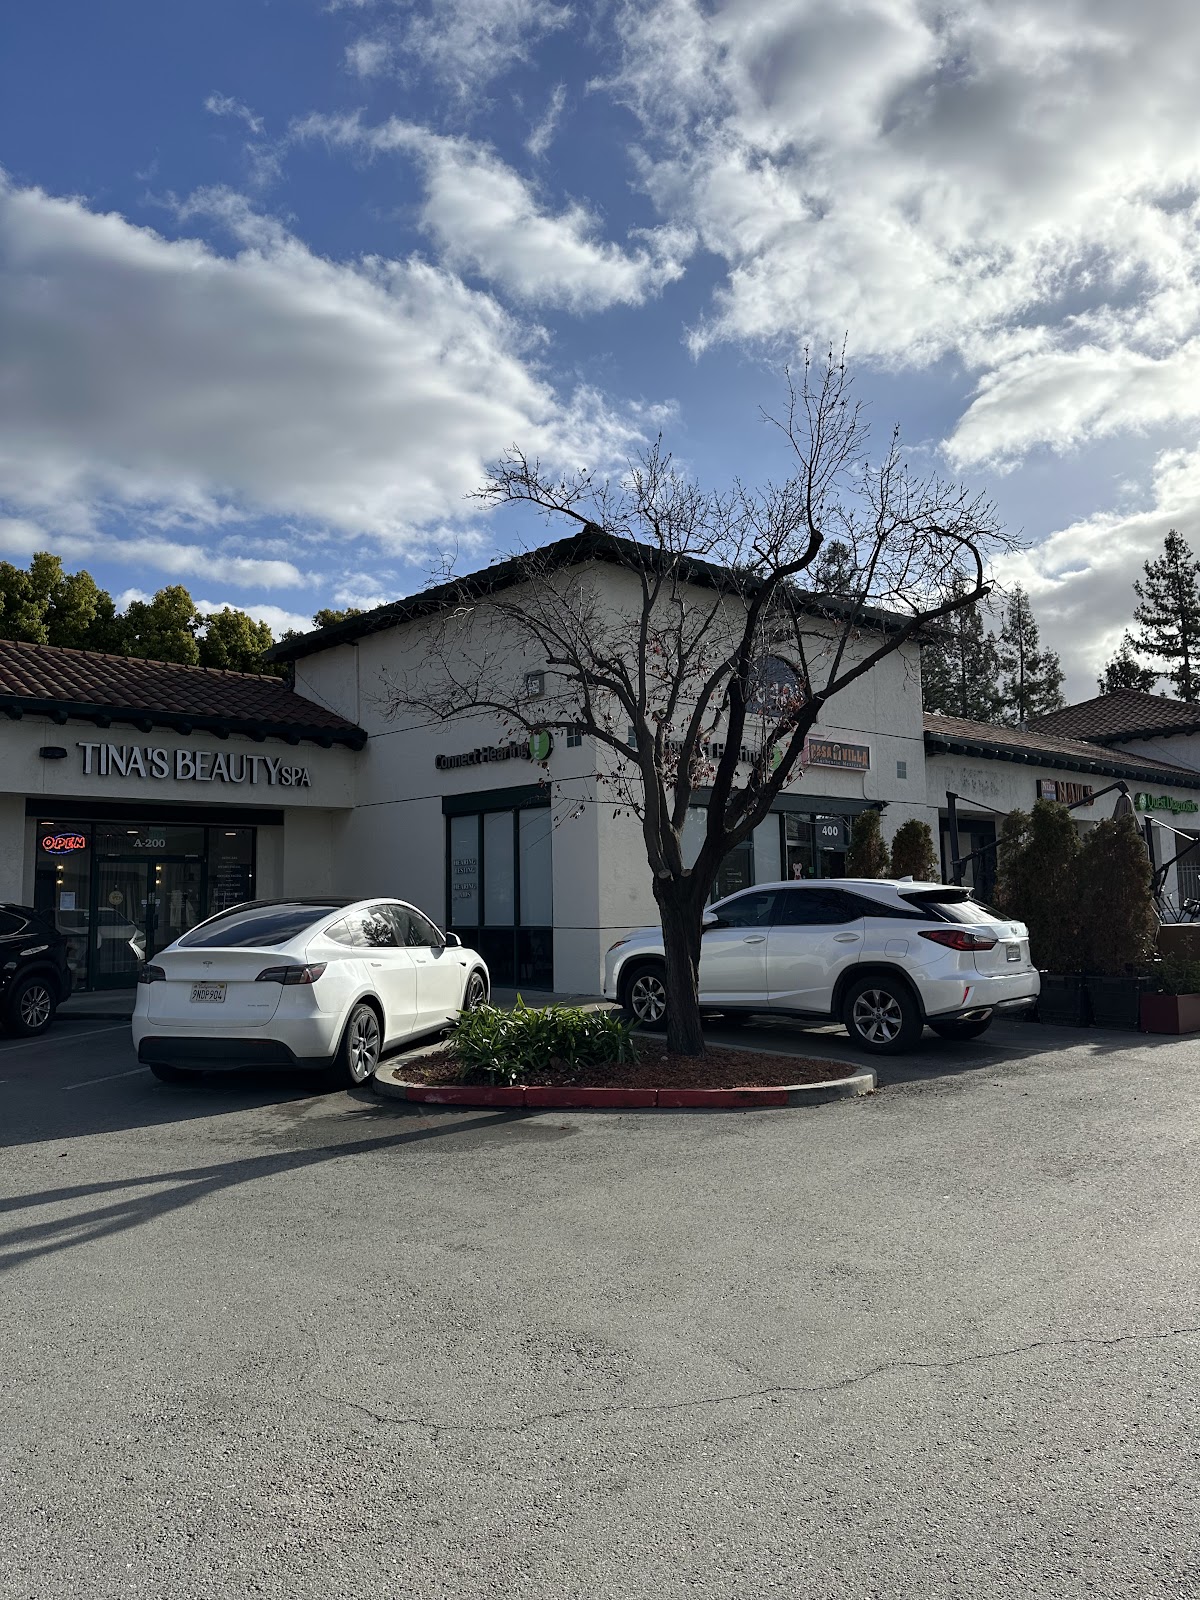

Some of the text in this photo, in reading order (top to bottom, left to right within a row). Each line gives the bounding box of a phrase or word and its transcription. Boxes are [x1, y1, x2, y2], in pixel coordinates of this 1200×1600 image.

[435, 741, 530, 769] Connect Hearing
[810, 744, 868, 766] CASA VILLA
[77, 742, 312, 787] TINA'S BEAUTY SPA
[843, 760, 863, 768] Mexican
[1147, 793, 1199, 815] Quest Diagnostics
[822, 826, 838, 836] 400
[42, 836, 86, 849] OPEN
[133, 838, 166, 848] A-200
[453, 858, 476, 866] HEARING
[453, 882, 476, 890] HEARING
[192, 989, 222, 1000] 9NDP904
